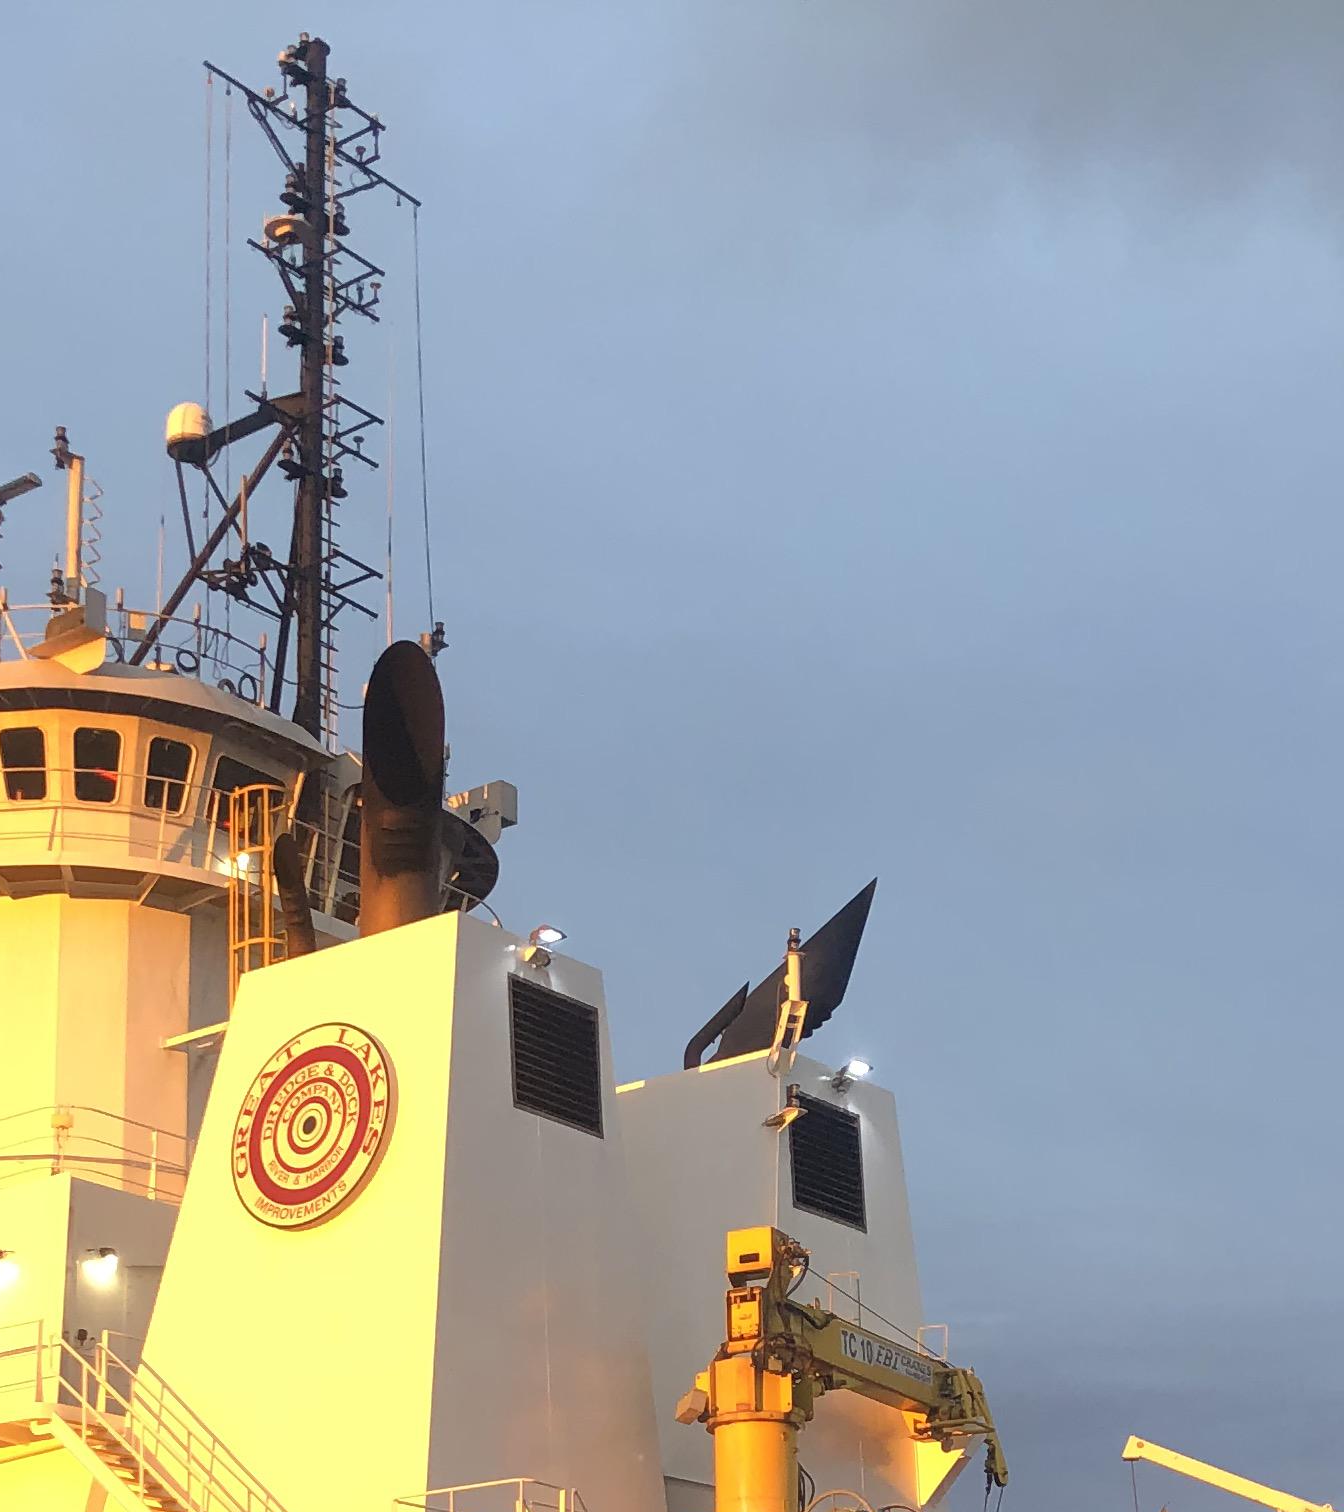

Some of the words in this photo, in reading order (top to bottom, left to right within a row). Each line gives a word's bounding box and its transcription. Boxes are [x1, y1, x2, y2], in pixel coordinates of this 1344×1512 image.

[235, 1040, 302, 1179] GREAT
[336, 1028, 386, 1156] LAKES
[263, 1065, 320, 1141] DREDGE
[324, 1064, 335, 1077] &
[338, 1071, 359, 1128] DOCK
[282, 1084, 342, 1124] COMPANY
[267, 1160, 289, 1184] RIVER
[305, 1146, 345, 1184] HARBOR
[254, 1180, 348, 1220] IMPROVEMENTS
[841, 1330, 858, 1358] TC
[860, 1340, 874, 1365] 10
